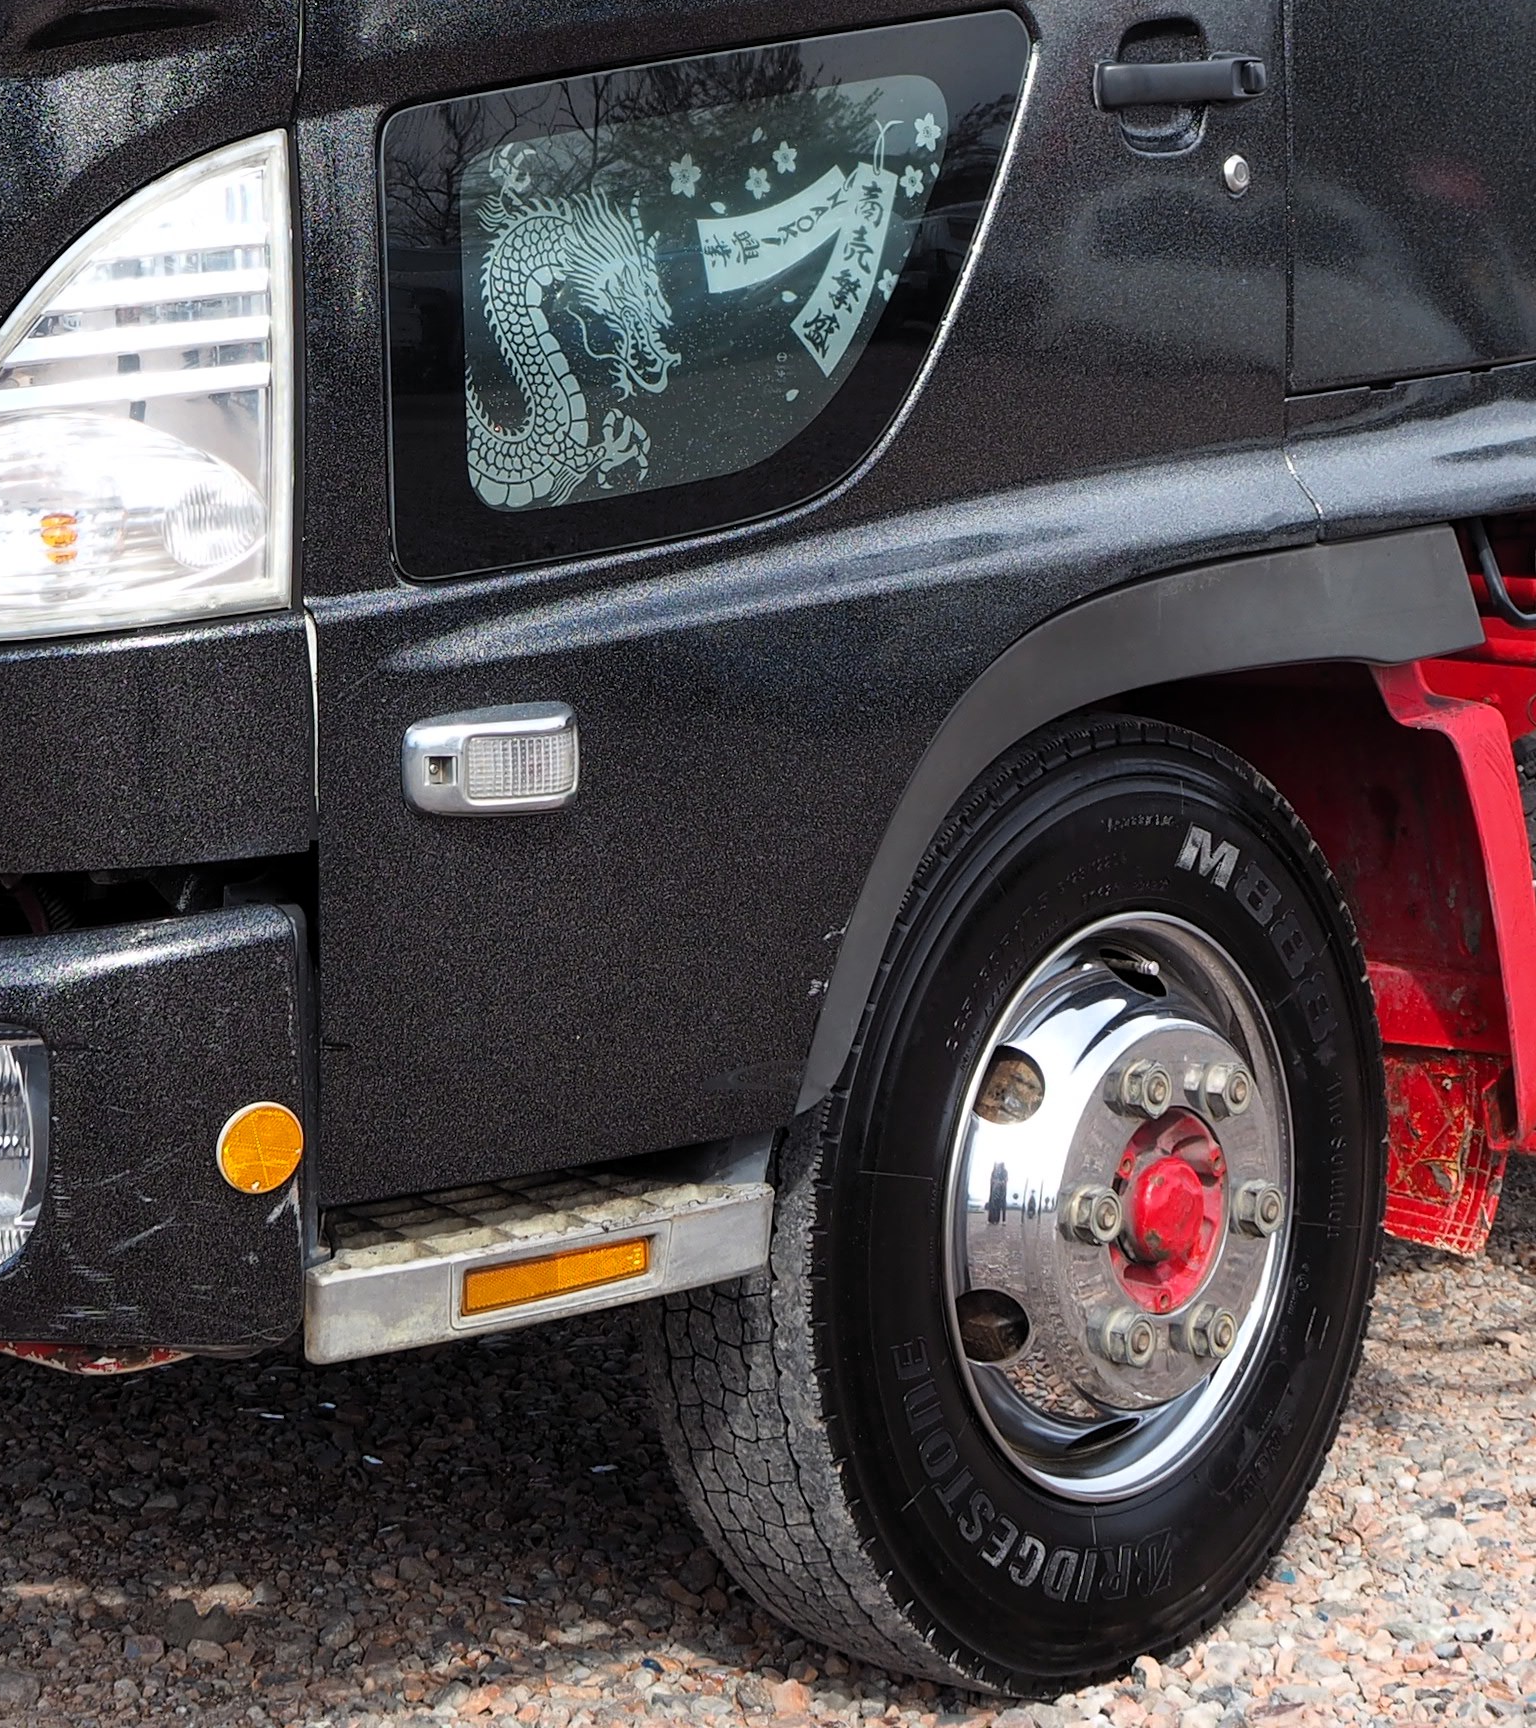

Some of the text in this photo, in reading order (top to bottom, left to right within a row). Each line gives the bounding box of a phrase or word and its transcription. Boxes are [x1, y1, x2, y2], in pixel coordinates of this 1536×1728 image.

[803, 181, 884, 359] 商売繁盛
[1174, 822, 1338, 1043] M888
[890, 1335, 1172, 1603] BRIDGESTONE
